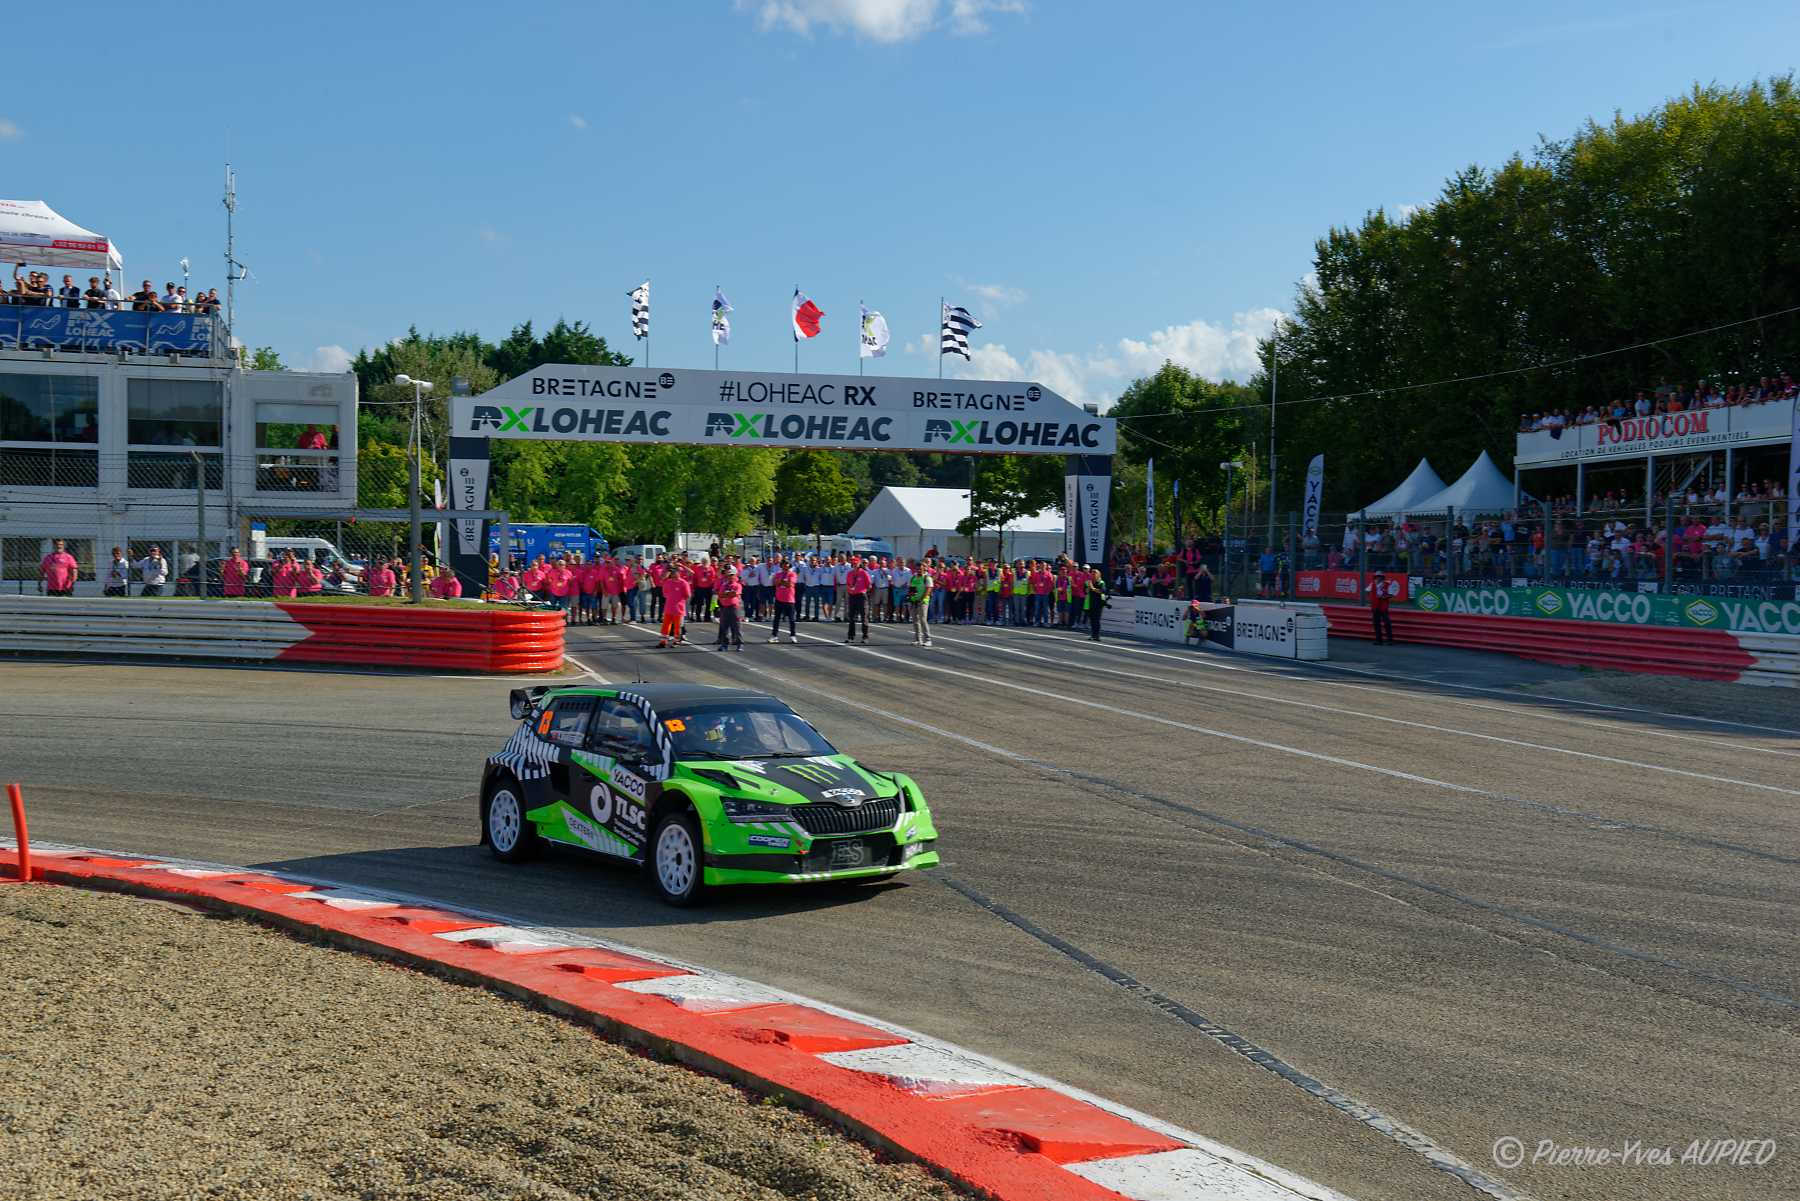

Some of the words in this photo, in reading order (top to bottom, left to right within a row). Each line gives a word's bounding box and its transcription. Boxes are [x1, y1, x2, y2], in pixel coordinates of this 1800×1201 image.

[533, 378, 656, 398] BRETAGNE
[720, 381, 834, 405] #LOHEAC
[845, 386, 876, 406] RX
[913, 392, 1025, 411] BRETAGNE
[1598, 412, 1709, 445] PODIOCOM
[465, 477, 475, 542] BREAGNE
[1305, 480, 1319, 529] YACC
[1090, 492, 1099, 552] BRETAGNE
[1442, 589, 1509, 615] YACCO
[1567, 591, 1650, 624] YACCO
[1135, 609, 1174, 629] BRETAGNE
[1237, 622, 1286, 642] BRETAGNE
[613, 768, 644, 796] YACCO
